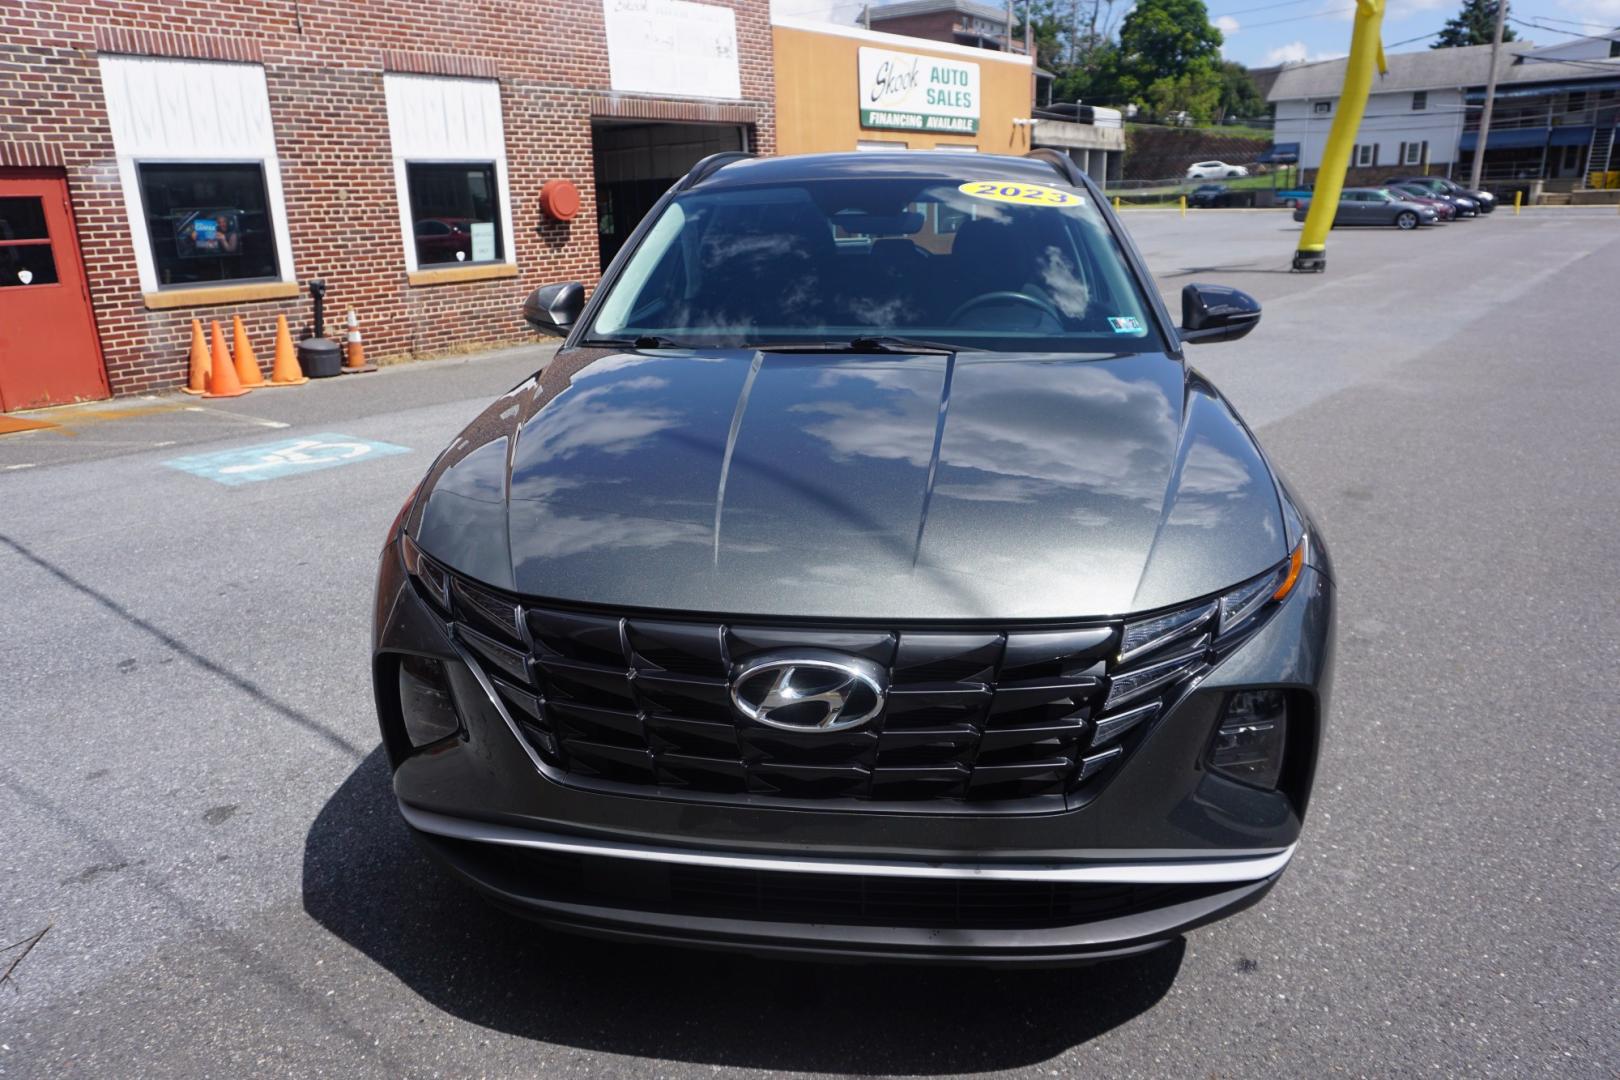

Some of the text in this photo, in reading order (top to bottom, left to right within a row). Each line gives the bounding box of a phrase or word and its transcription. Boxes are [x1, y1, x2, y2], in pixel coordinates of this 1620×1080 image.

[871, 57, 919, 102] Skook
[930, 66, 968, 86] AUTO
[926, 88, 972, 108] SALES
[868, 111, 974, 130] FINANCING AVAILABLE
[975, 184, 1068, 203] 2023
